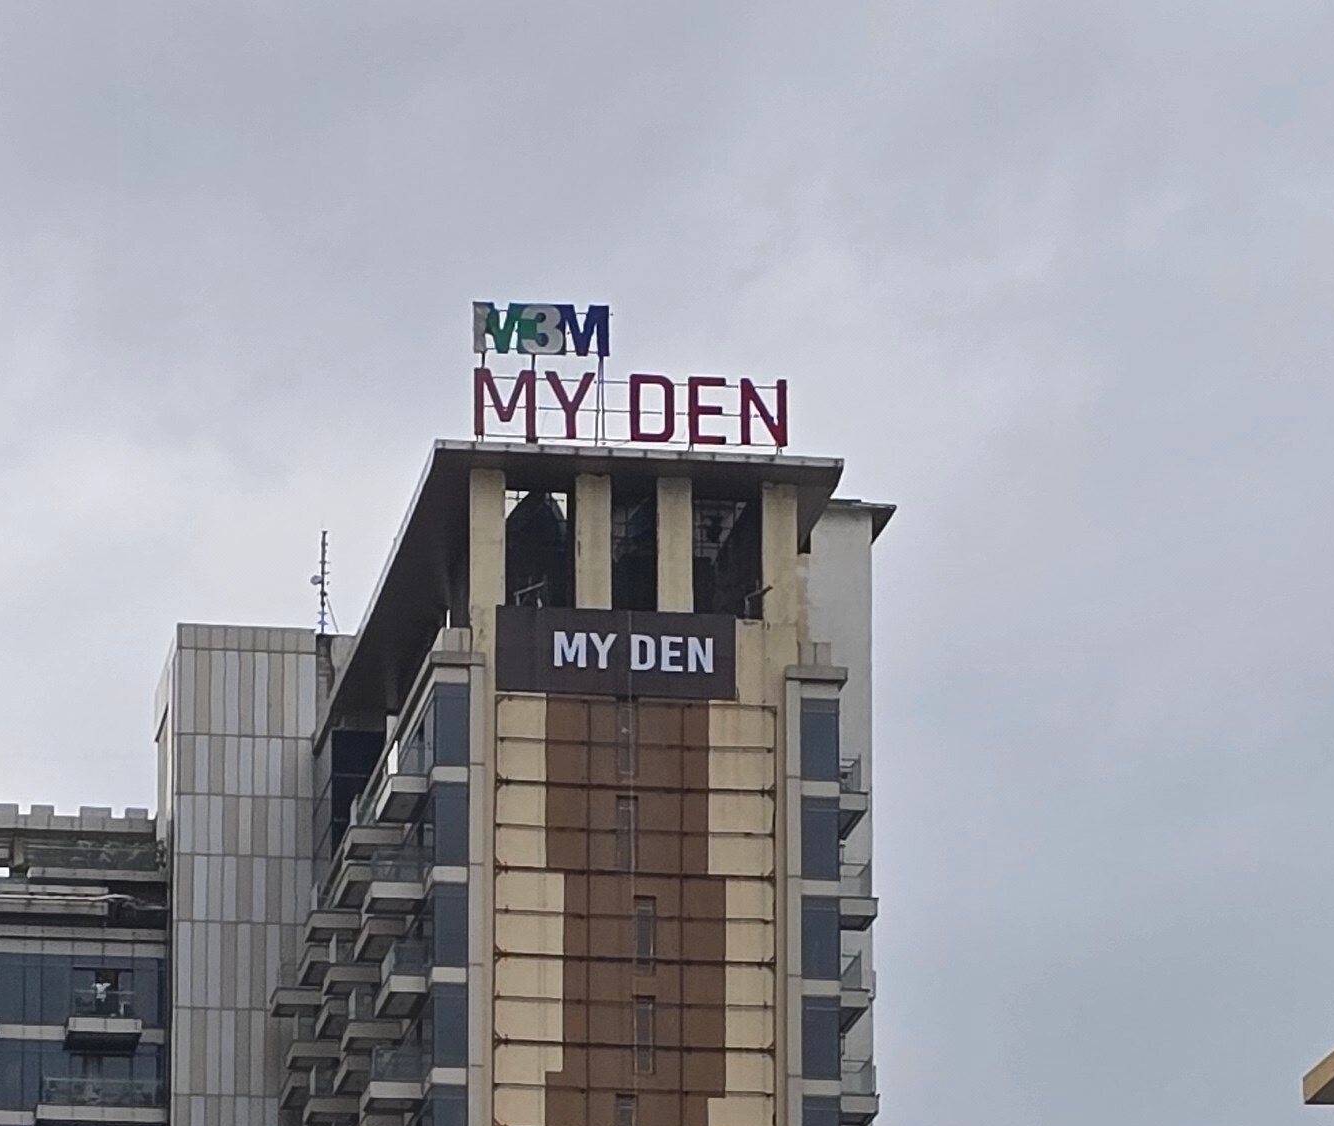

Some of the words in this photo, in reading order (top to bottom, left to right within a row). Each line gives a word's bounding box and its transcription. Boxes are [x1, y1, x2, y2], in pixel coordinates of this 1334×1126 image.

[472, 301, 610, 356] M3M
[473, 367, 596, 444] MY
[629, 373, 788, 447] DEN
[553, 630, 618, 670] MY
[630, 632, 715, 674] DEN
